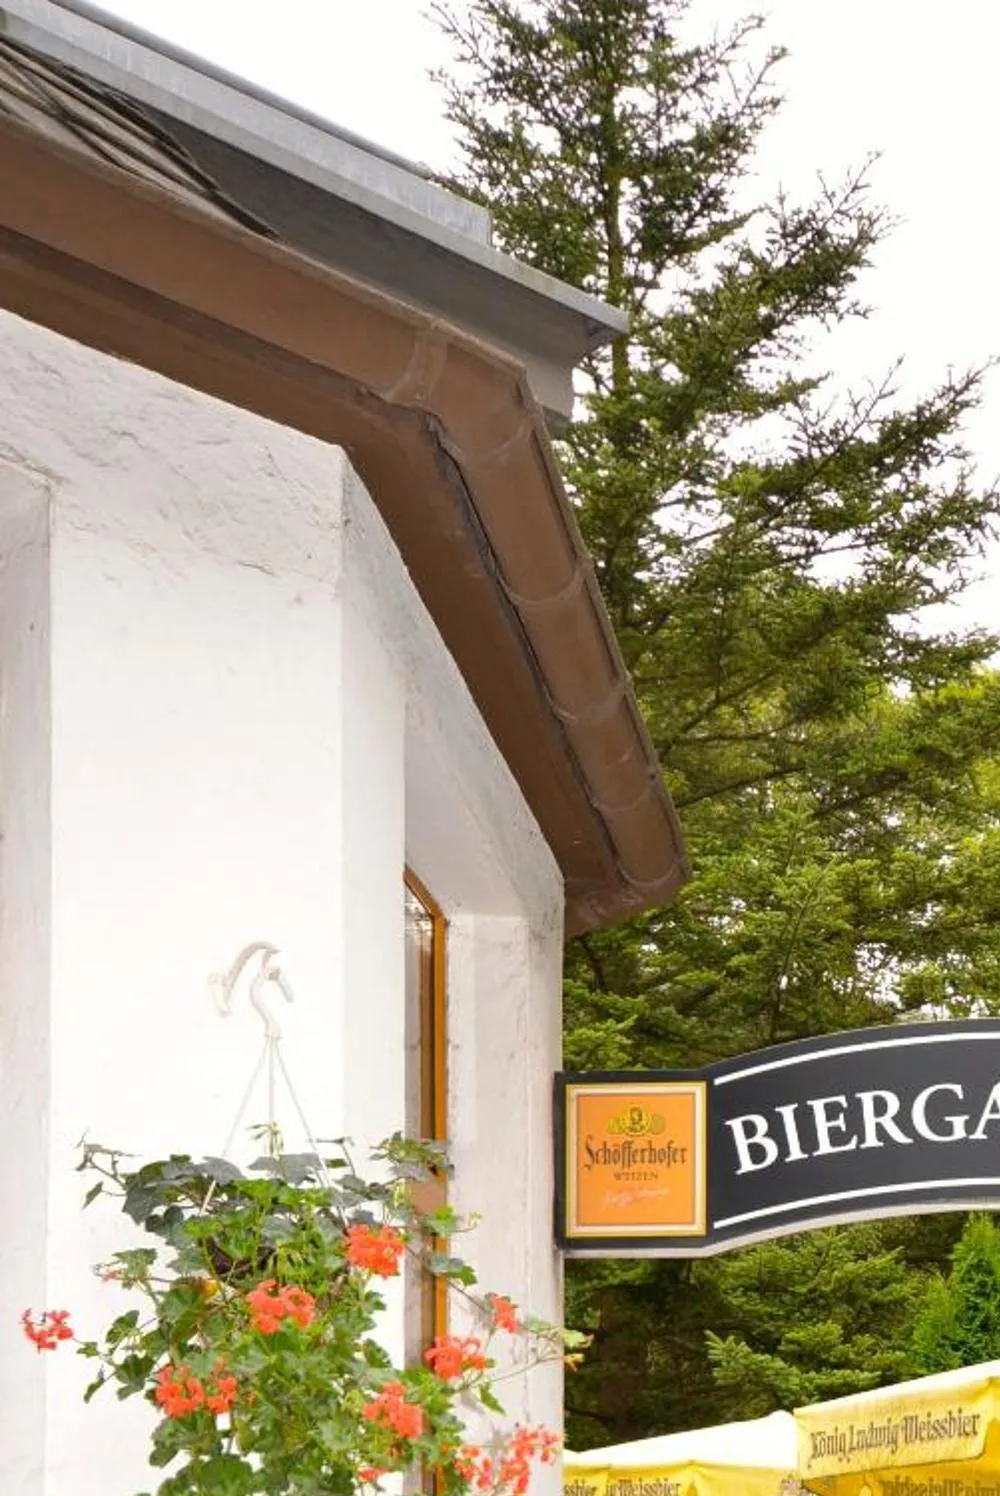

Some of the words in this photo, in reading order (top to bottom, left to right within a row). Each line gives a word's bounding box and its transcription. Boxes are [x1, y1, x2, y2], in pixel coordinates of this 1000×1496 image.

[583, 1133, 688, 1172] Schöfferhofer
[808, 1425, 848, 1469] König
[848, 1417, 900, 1463] Ludwig
[900, 1407, 981, 1444] Weissbier
